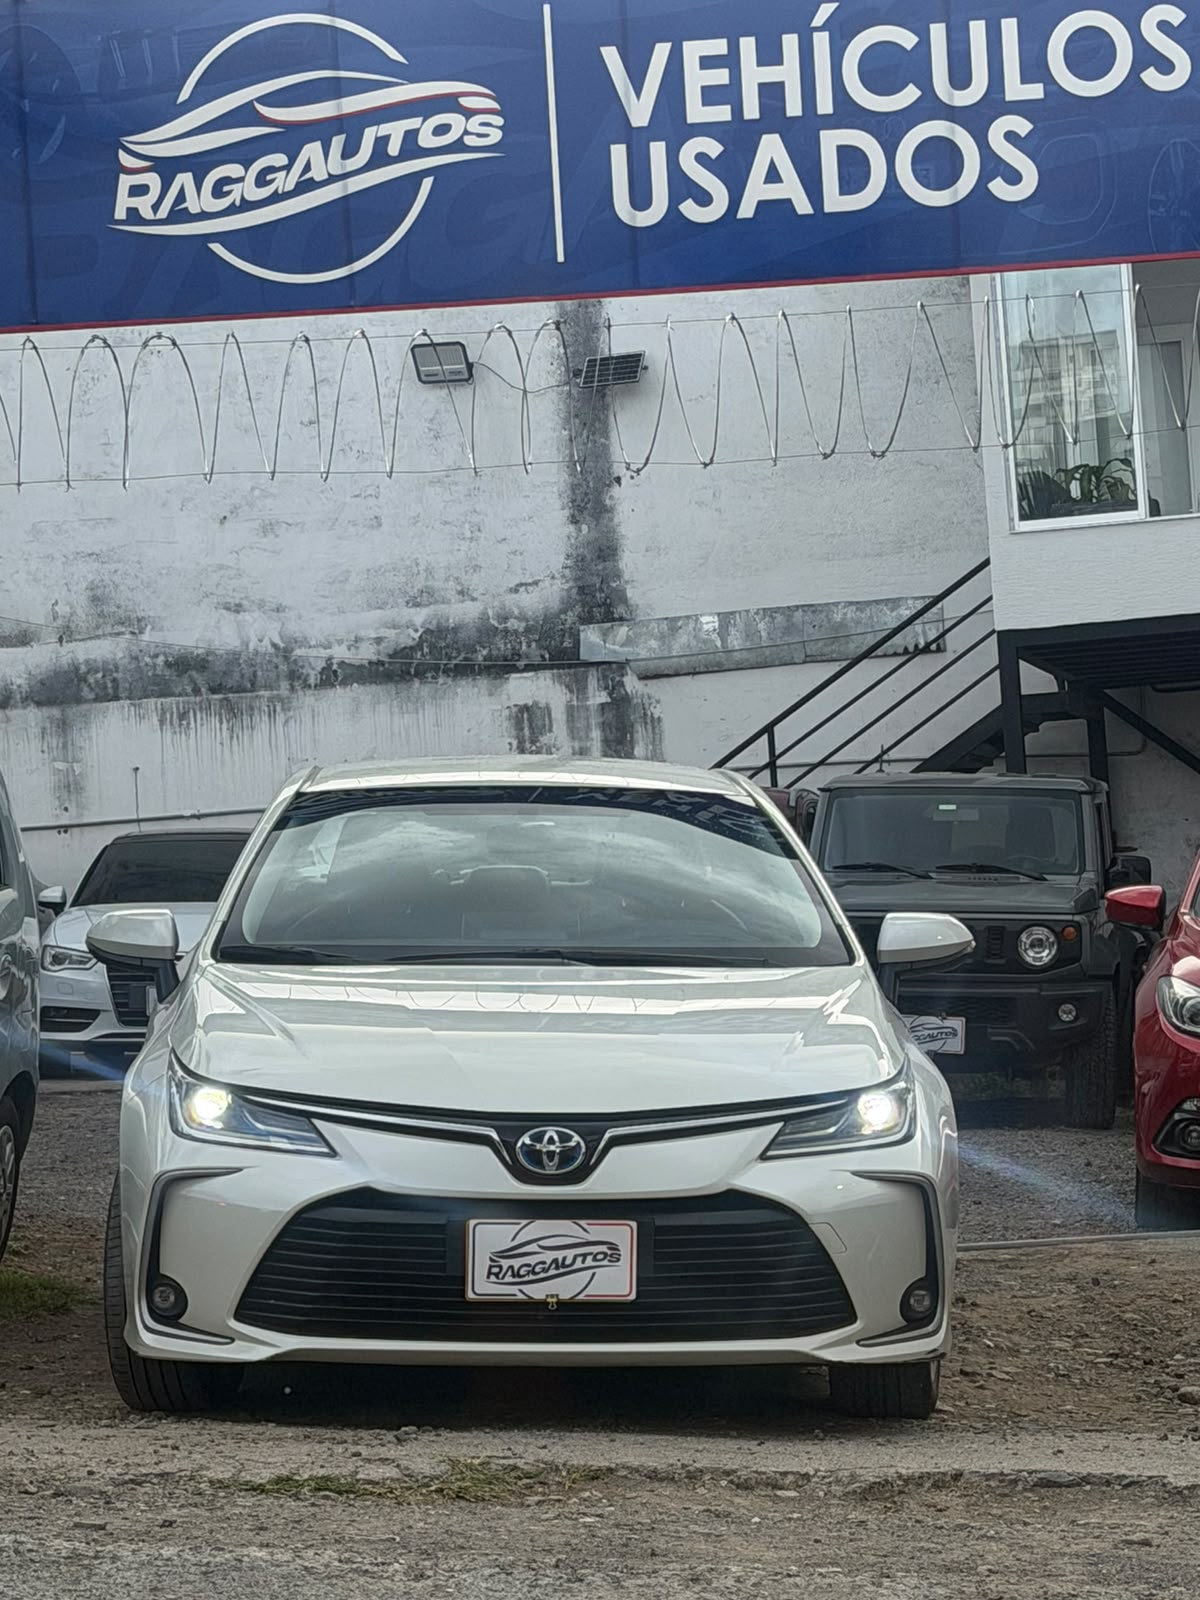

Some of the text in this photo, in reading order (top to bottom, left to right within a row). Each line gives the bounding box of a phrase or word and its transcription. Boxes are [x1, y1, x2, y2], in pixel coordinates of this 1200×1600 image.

[600, 3, 1191, 127] VEHÍCULOS
[115, 113, 504, 219] RAGGAUTOS
[610, 115, 1038, 226] USADOS
[911, 1030, 958, 1041] GGAUTOS
[486, 1251, 621, 1281] RAGGAUTOS
